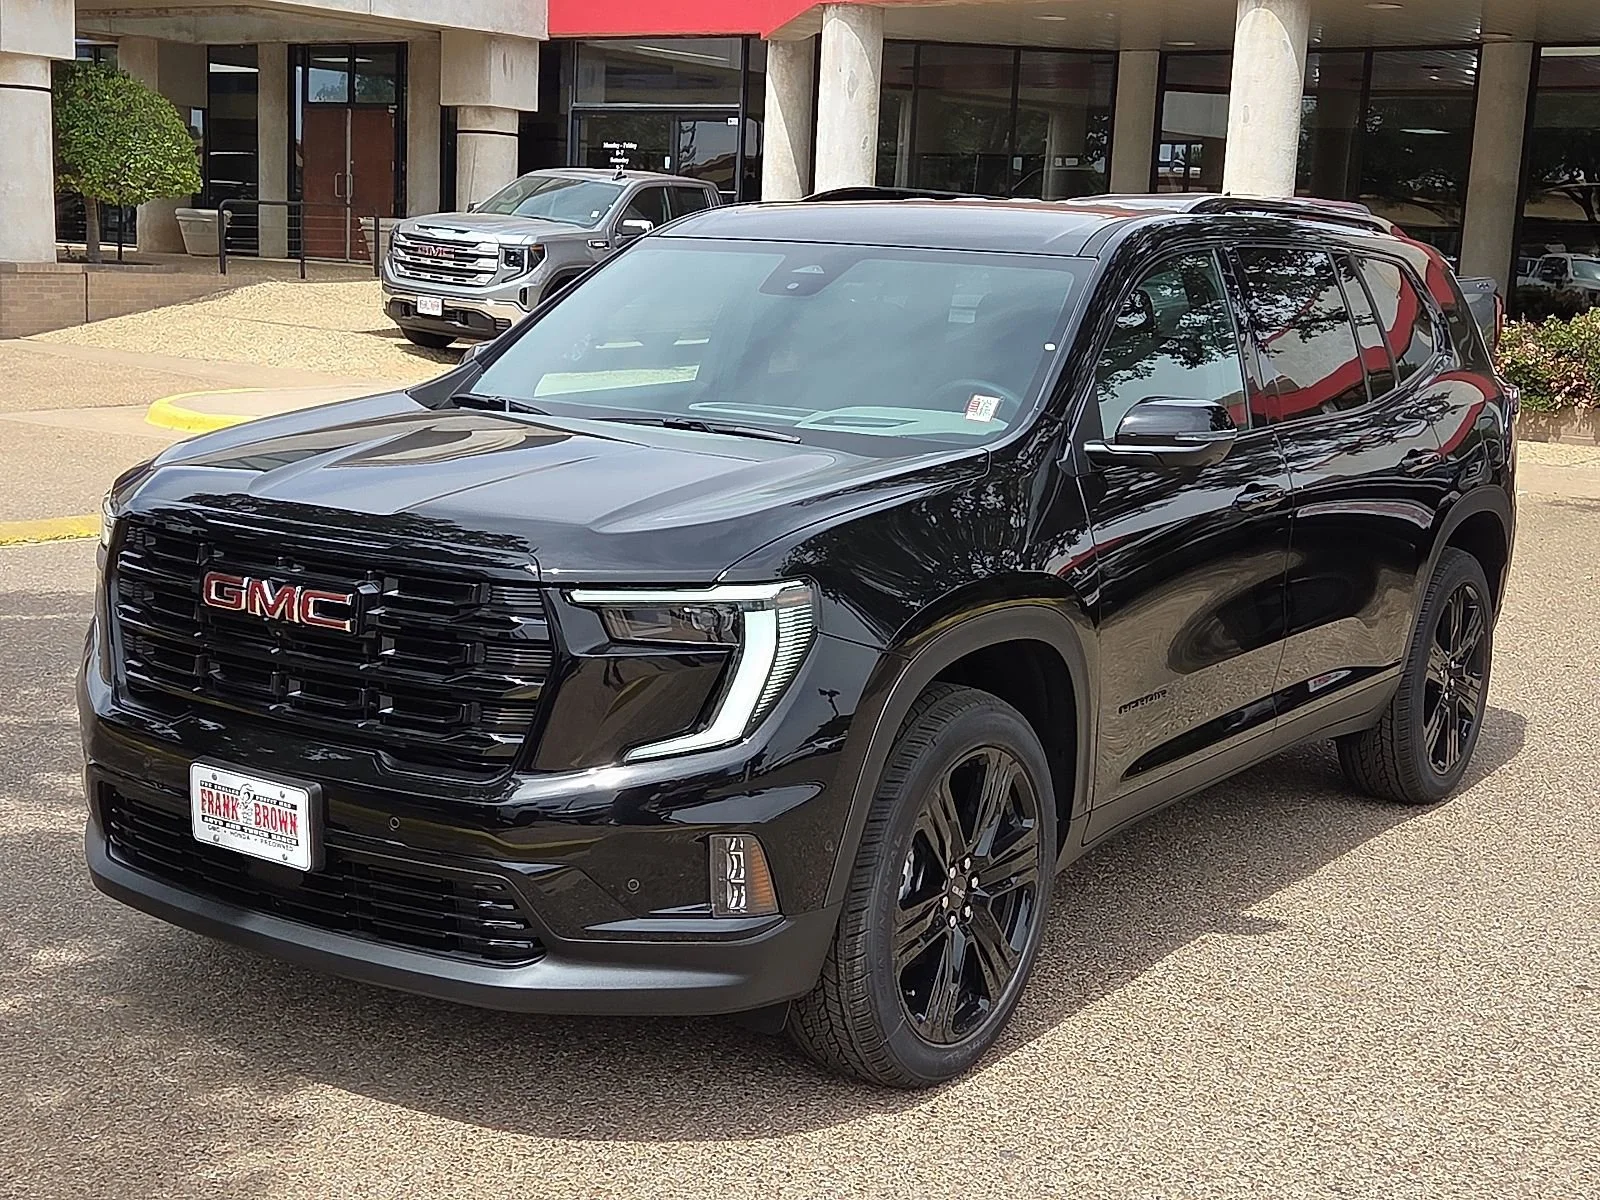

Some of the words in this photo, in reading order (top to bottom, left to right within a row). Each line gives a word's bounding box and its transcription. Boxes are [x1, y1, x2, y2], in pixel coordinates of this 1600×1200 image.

[203, 571, 353, 632] GMC
[200, 788, 240, 822] FRANK
[254, 802, 298, 837] BROWN
